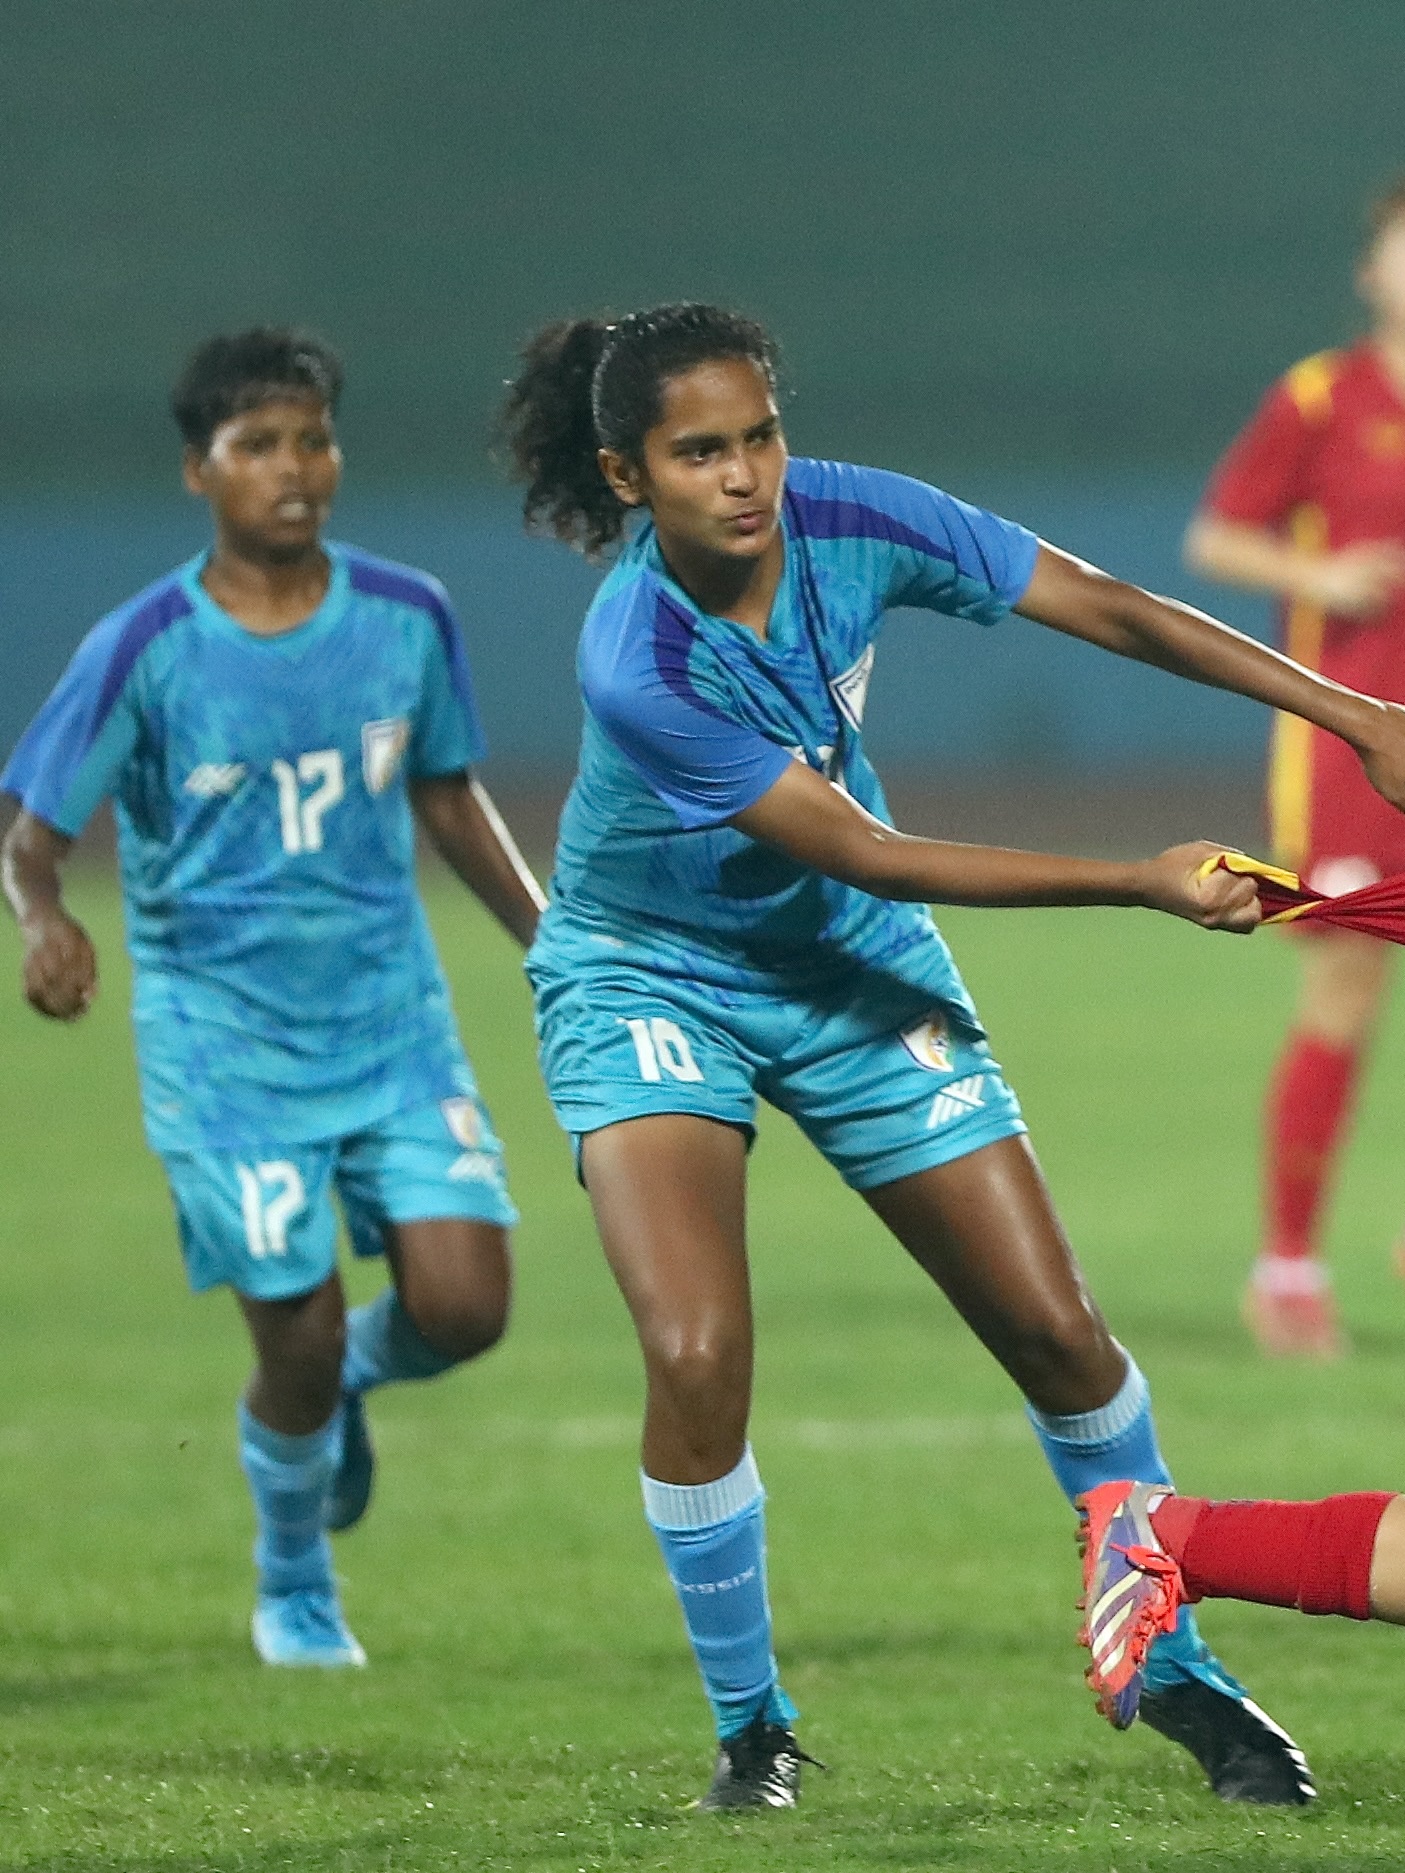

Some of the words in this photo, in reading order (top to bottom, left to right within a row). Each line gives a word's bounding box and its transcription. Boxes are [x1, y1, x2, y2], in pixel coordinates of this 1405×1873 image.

[271, 748, 344, 856] 17
[616, 1016, 705, 1082] 10
[236, 1160, 305, 1259] 17
